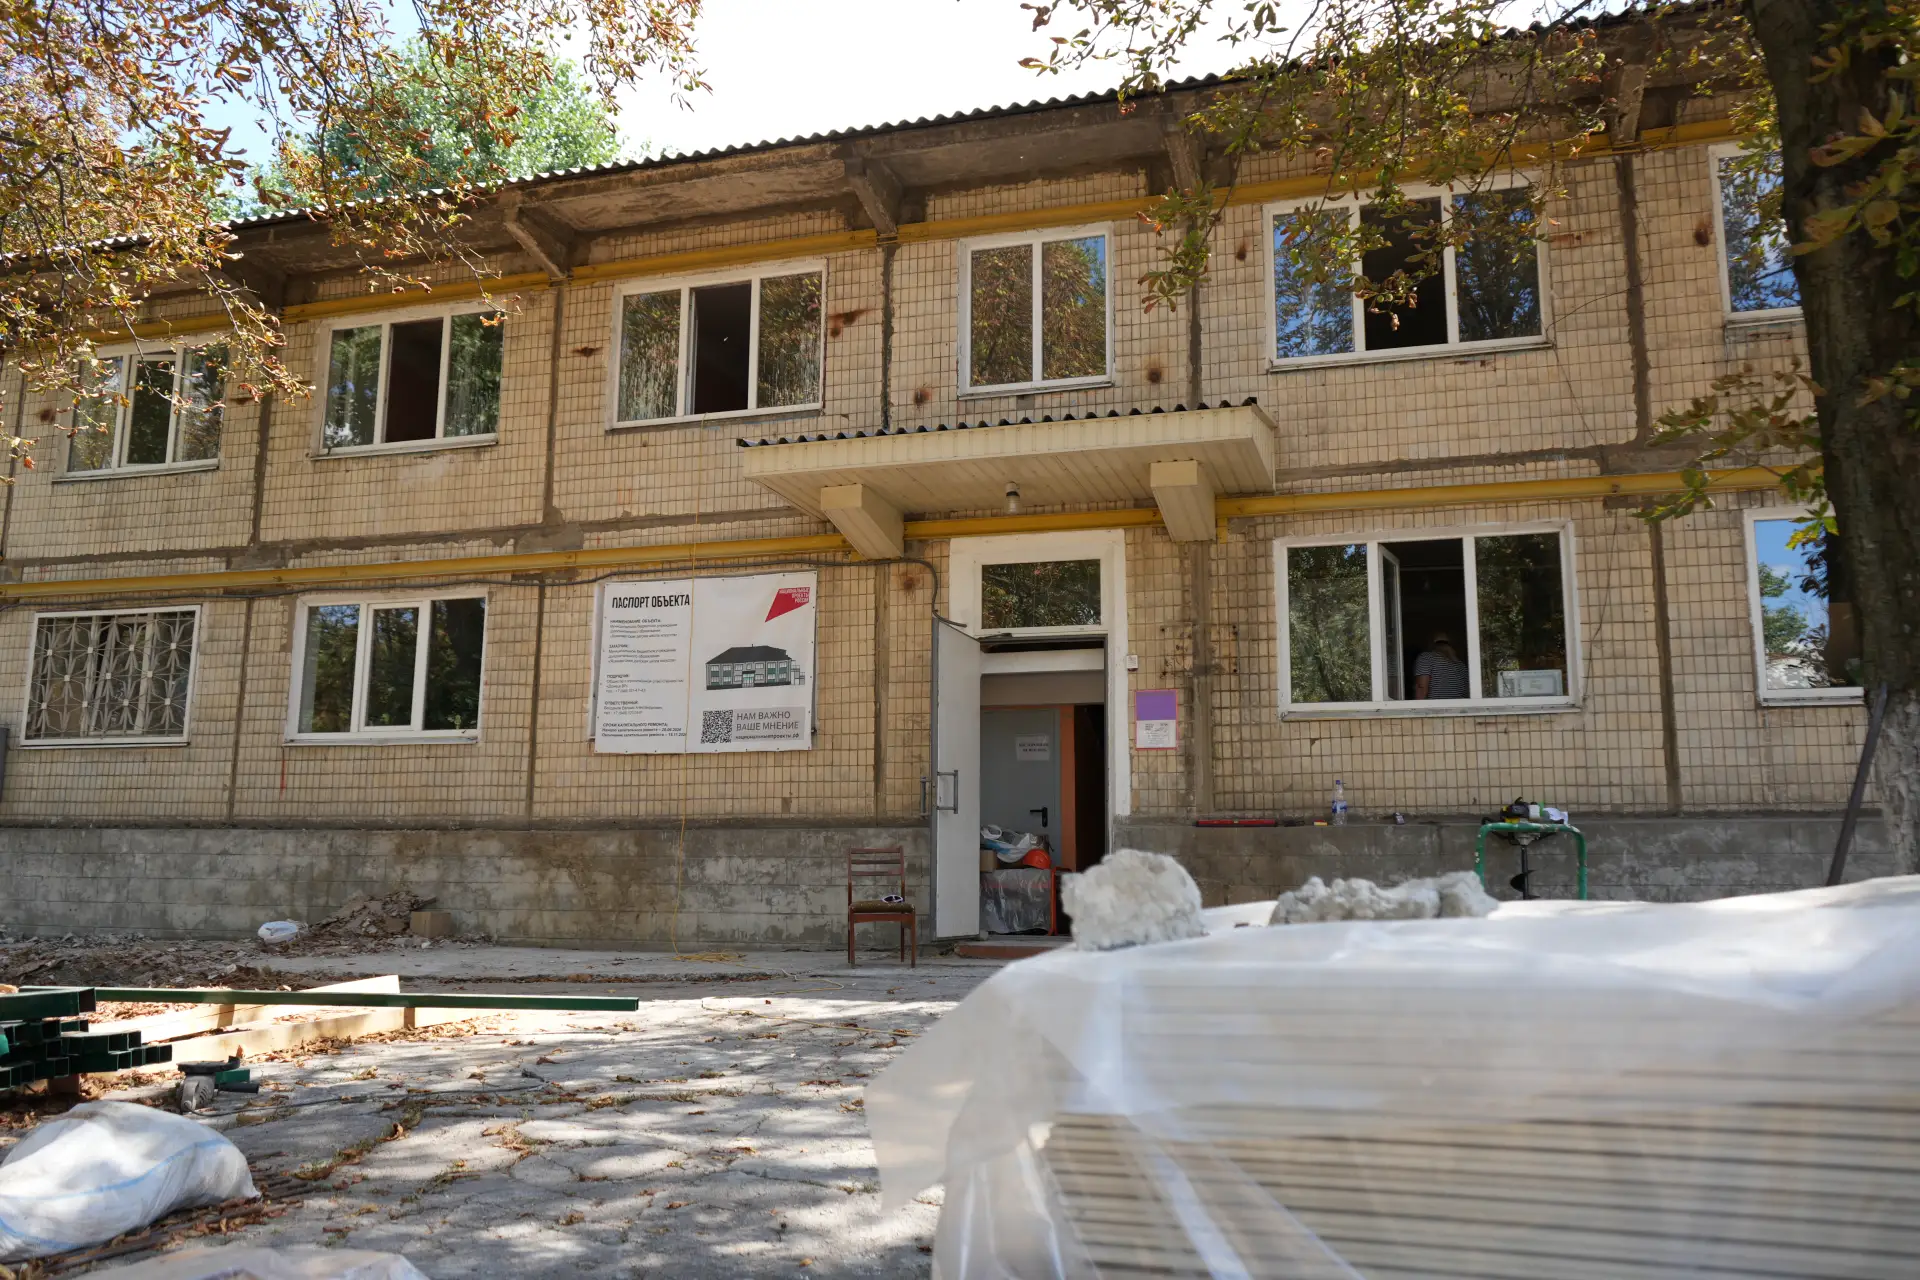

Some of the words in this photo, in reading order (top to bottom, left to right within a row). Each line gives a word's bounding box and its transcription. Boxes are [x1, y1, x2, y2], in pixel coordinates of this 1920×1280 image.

[612, 596, 650, 608] ПАСПОРТ
[651, 594, 690, 607] ОБЪЕКТА
[736, 712, 756, 720] НАМ
[758, 711, 791, 720] ВАЖНО
[736, 722, 761, 731] ВАШЕ
[762, 721, 800, 730] МНЕНИЕ
